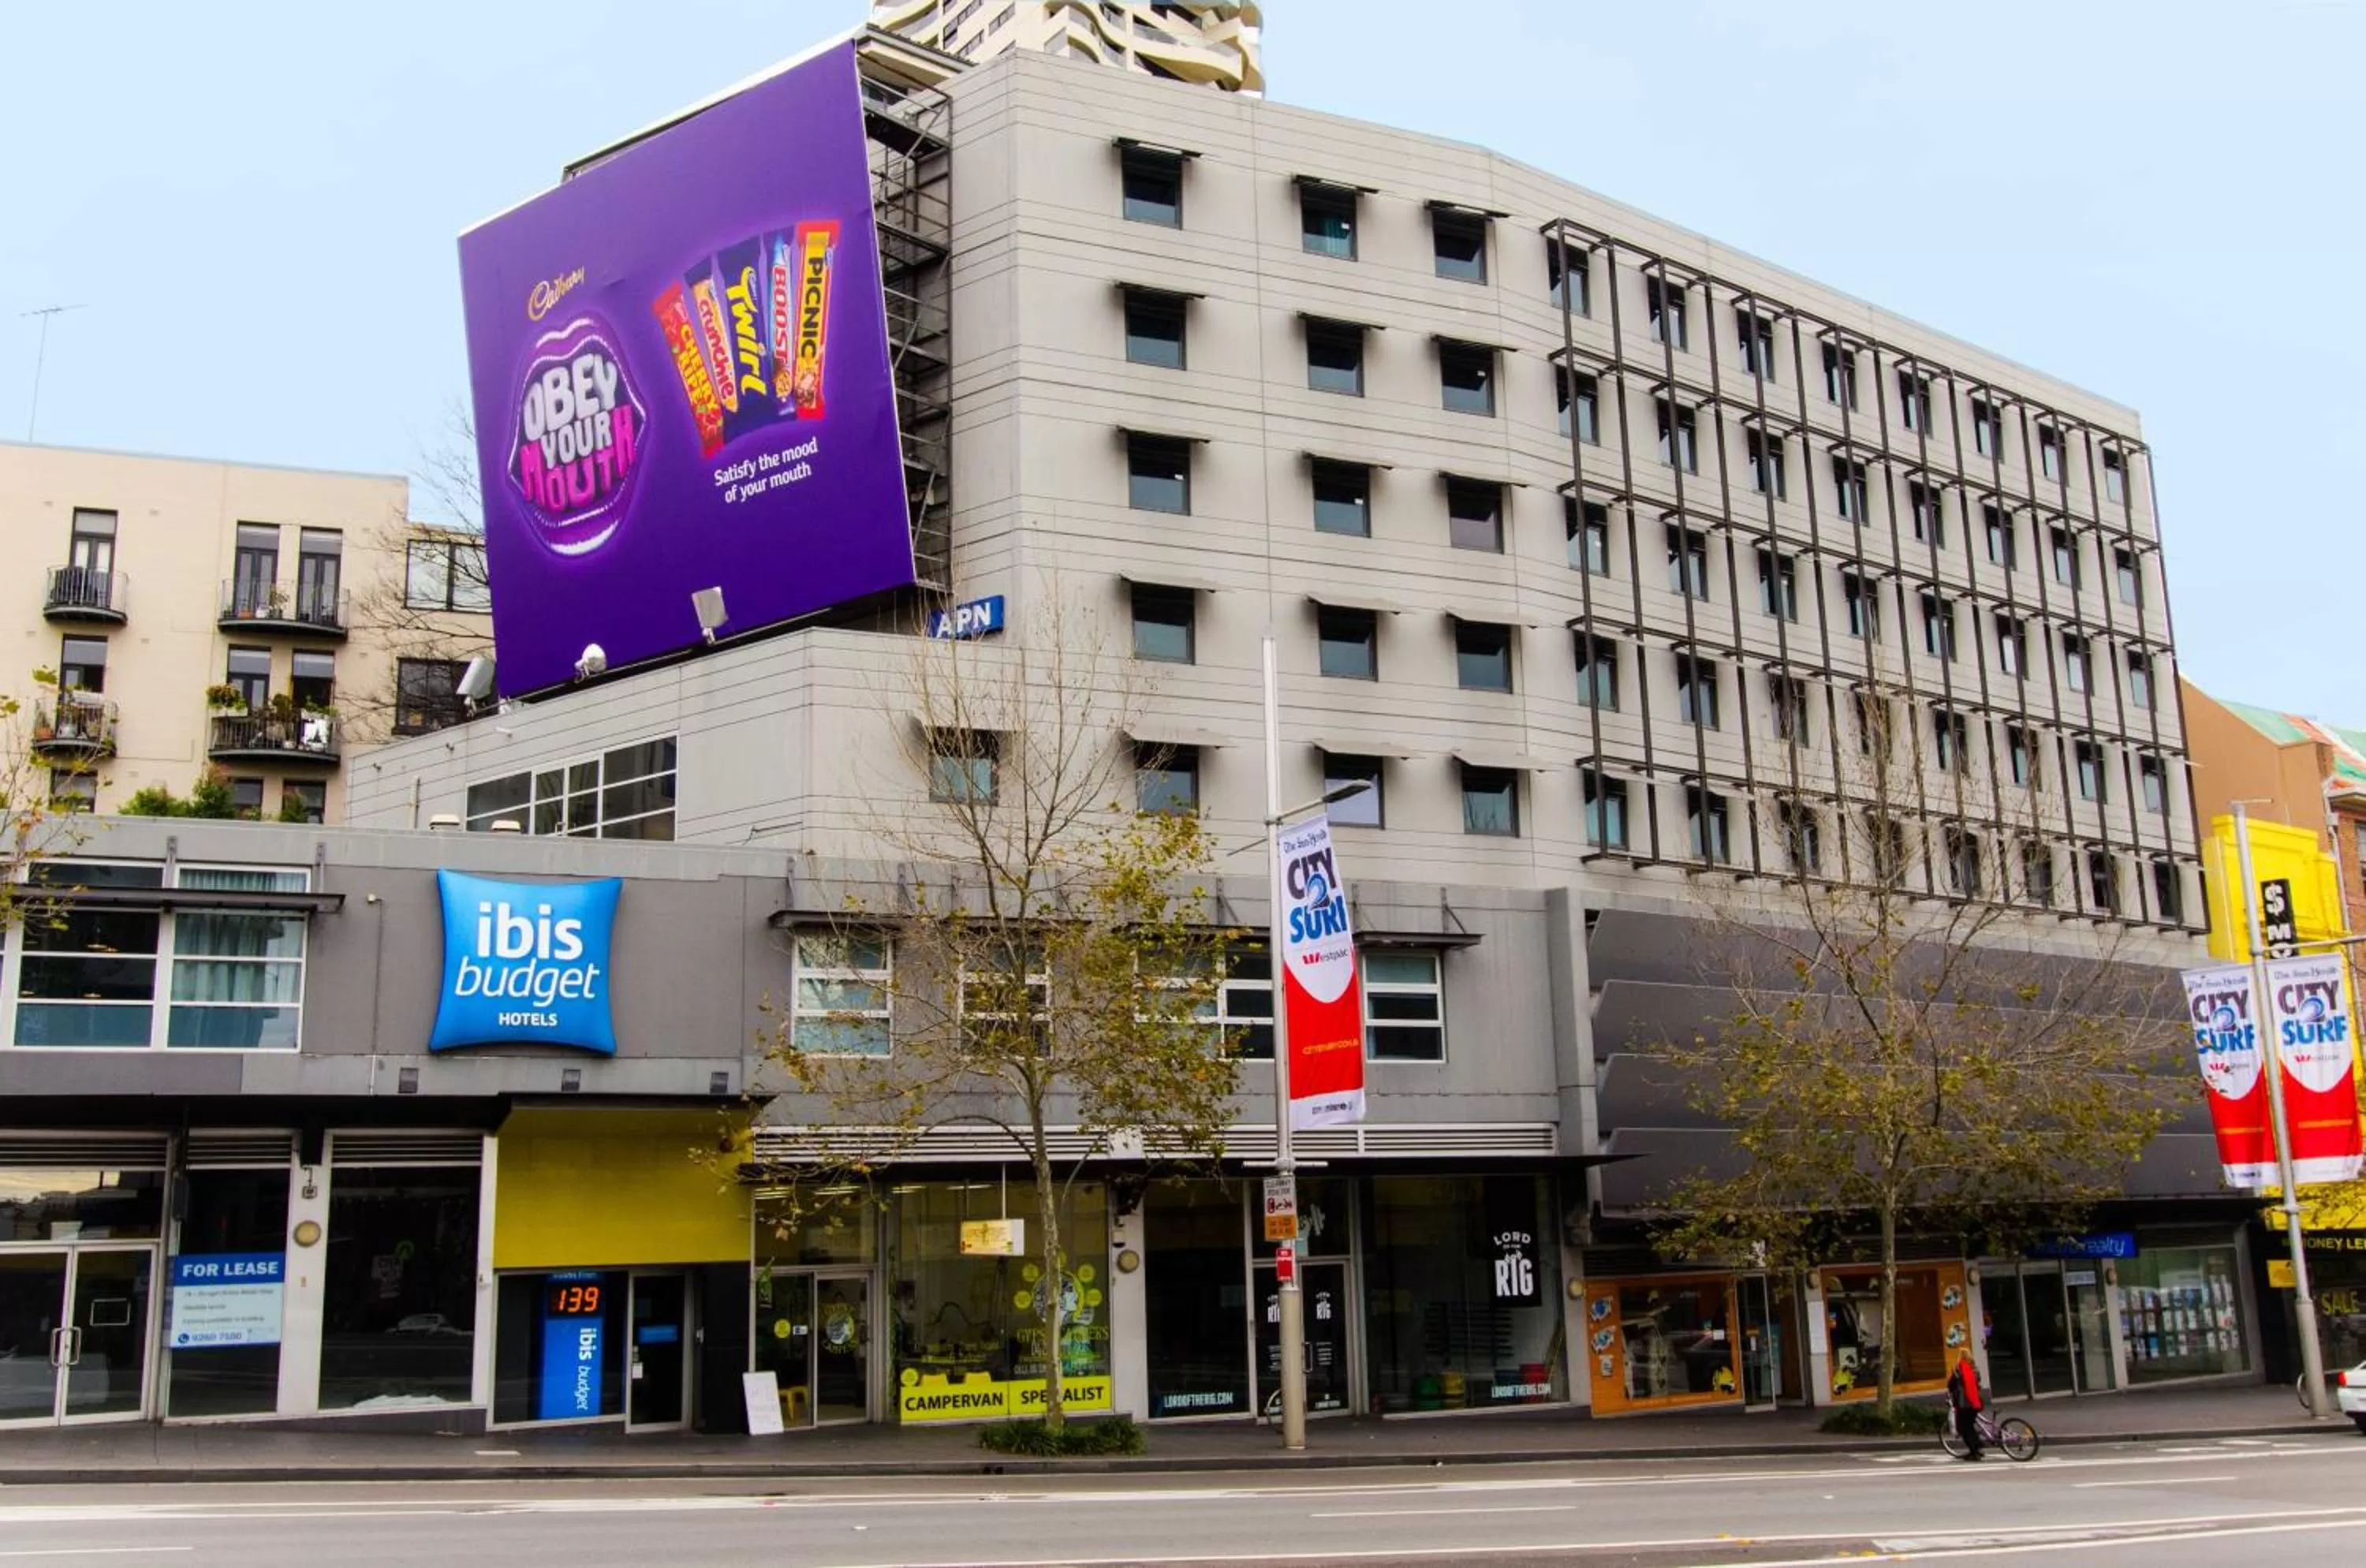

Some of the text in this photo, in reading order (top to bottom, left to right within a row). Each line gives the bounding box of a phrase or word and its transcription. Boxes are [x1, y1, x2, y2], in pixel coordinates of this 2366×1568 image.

[528, 265, 584, 321] Cadbury
[772, 264, 789, 362] BOOST
[800, 256, 823, 359] PICNIC
[678, 351, 703, 405] RIPE
[681, 323, 720, 410] CHERRY
[524, 353, 617, 442] OBEY
[521, 404, 636, 513] MOUTH
[541, 410, 613, 469] YOUR
[714, 435, 819, 487] Satisfy the mood
[725, 461, 812, 504] of your mouth
[936, 602, 991, 638] APN
[1287, 847, 1337, 899] CITY
[477, 902, 583, 960] ibis
[454, 956, 600, 1007] budget
[2278, 980, 2338, 1014] CITY
[498, 1012, 558, 1026] HOTELS
[2192, 988, 2249, 1023] CITY
[2196, 1023, 2255, 1055] SURF
[2282, 1015, 2348, 1046] SURF
[1493, 1231, 1531, 1245] LORD
[182, 1261, 278, 1278] FOR LEASE
[1495, 1258, 1534, 1297] RIG
[558, 1286, 600, 1312] 139
[1316, 1301, 1331, 1320] RIG
[2321, 1290, 2360, 1316] SALE
[574, 1327, 597, 1411] ibis budget
[905, 1386, 1105, 1411] CAMPERVAN SPEALIST
